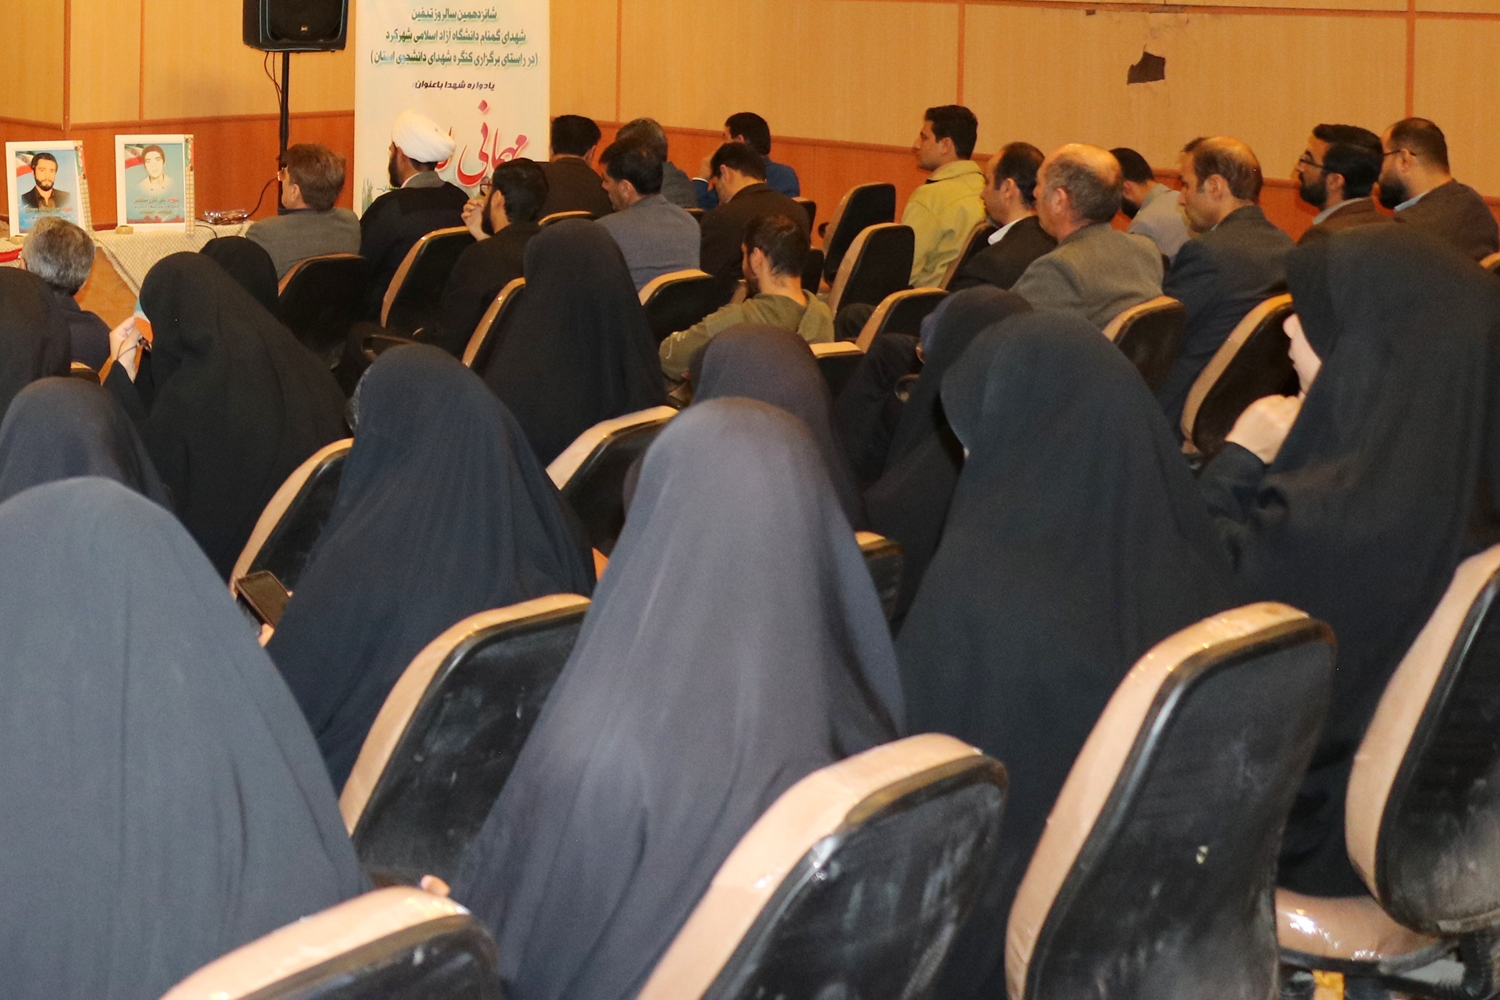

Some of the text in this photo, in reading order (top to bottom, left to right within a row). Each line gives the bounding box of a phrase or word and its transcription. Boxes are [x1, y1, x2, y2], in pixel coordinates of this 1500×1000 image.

[411, 7, 434, 21] تدفین
[457, 6, 497, 22] شانزدهمین
[414, 30, 438, 43] اسلامی
[439, 28, 451, 43] آزاد
[452, 28, 479, 41] دانشگاه
[480, 29, 501, 45] گمنام
[501, 29, 526, 44] شهدای
[395, 49, 427, 65] دانشجوی
[428, 49, 451, 65] شهدای
[453, 50, 473, 66] کنگره
[474, 51, 500, 67] برگزاری
[501, 53, 526, 67] راستای
[445, 80, 466, 90] شهدا
[467, 82, 495, 91] یادواره
